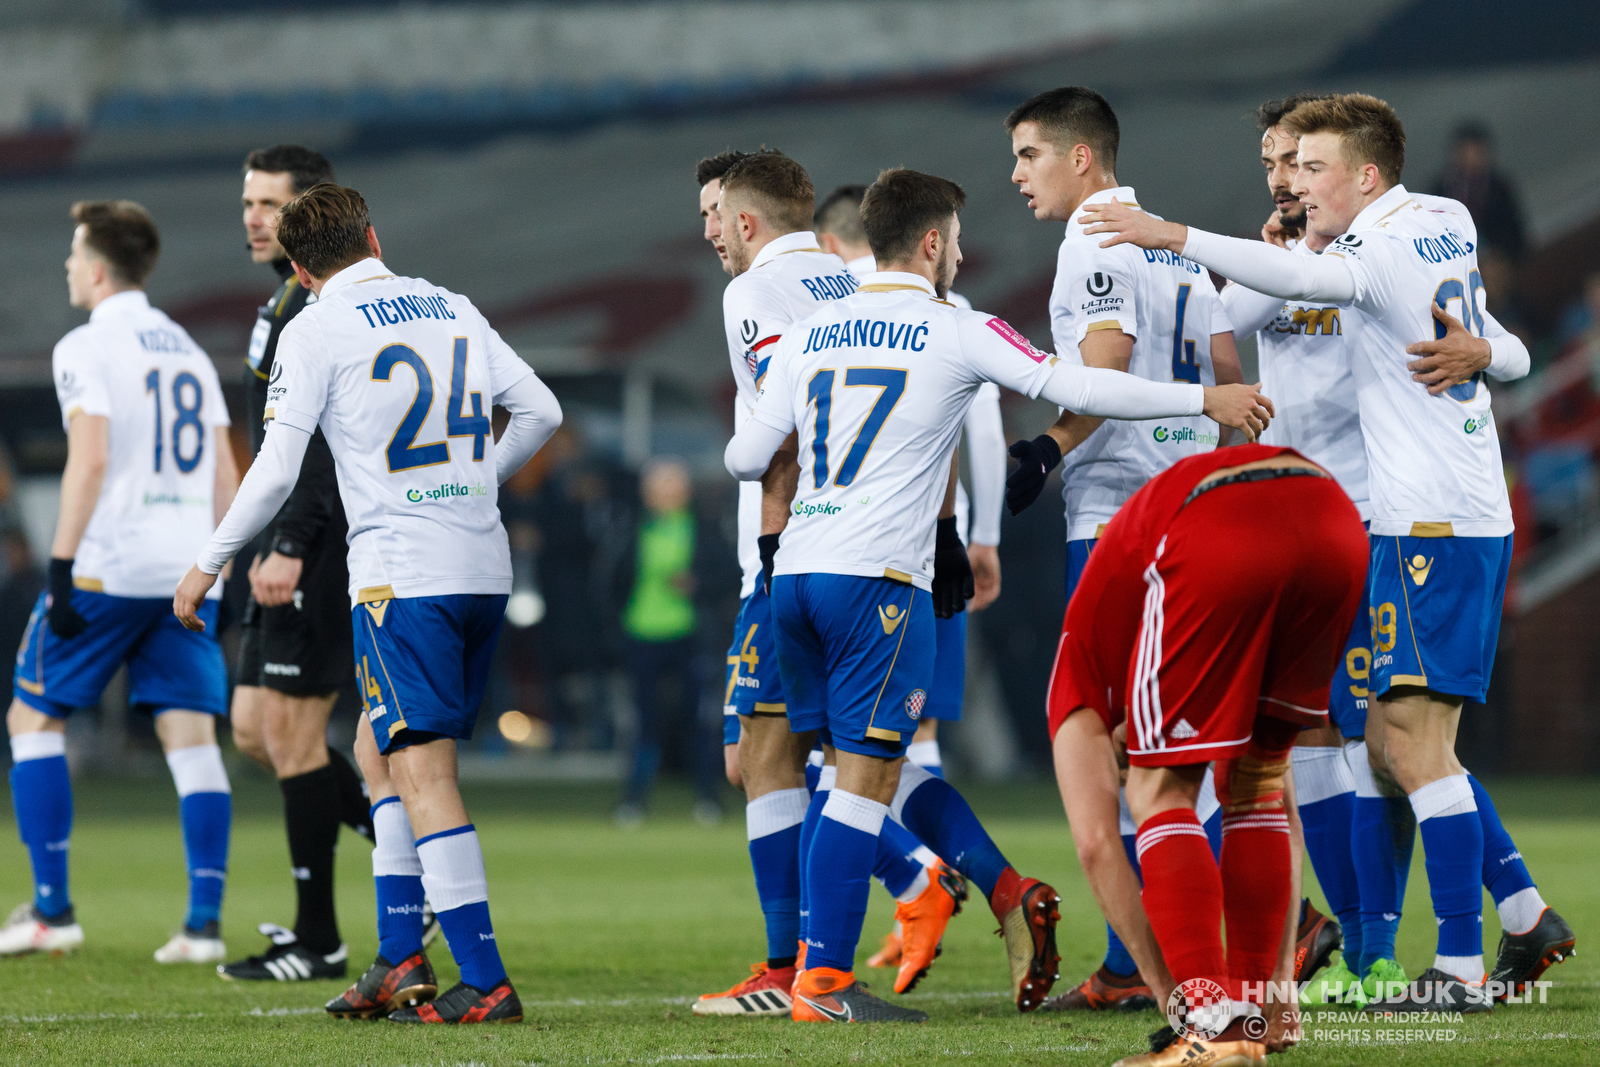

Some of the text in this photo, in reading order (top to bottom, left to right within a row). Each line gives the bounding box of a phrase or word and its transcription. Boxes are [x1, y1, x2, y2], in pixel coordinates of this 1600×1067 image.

[356, 293, 456, 328] TIČINOVIĆ
[803, 319, 929, 354] JURANOVIĆ
[1081, 297, 1124, 310] ULTRA
[1087, 305, 1121, 315] EUROPE
[1172, 283, 1200, 384] 4
[145, 369, 204, 473] 18
[370, 336, 491, 473] 24
[806, 366, 909, 490] 17
